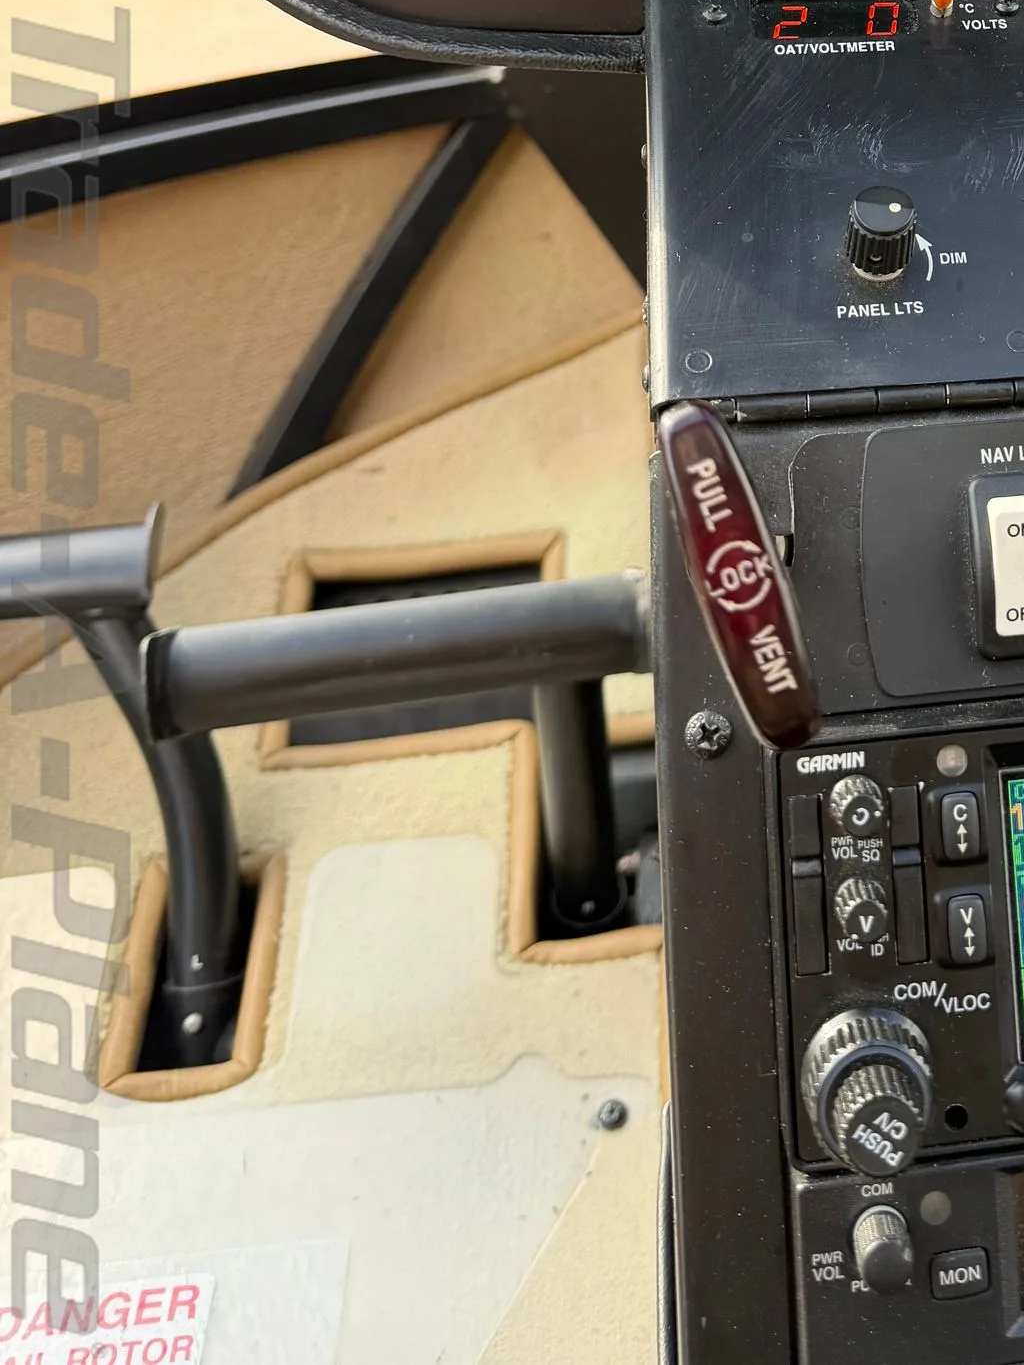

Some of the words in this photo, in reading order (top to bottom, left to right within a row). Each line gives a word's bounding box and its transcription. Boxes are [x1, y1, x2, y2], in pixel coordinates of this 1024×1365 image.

[962, 18, 1008, 31] VOLTS
[774, 40, 896, 56] OAT/VOLTMETER
[939, 251, 968, 265] DIM
[836, 303, 890, 319] PANEL
[894, 300, 924, 316] LTS
[980, 446, 1010, 464] NAV
[686, 457, 733, 533] PULL
[749, 623, 798, 694] VENT
[796, 750, 866, 774] GARMIN
[939, 1265, 982, 1286] MON
